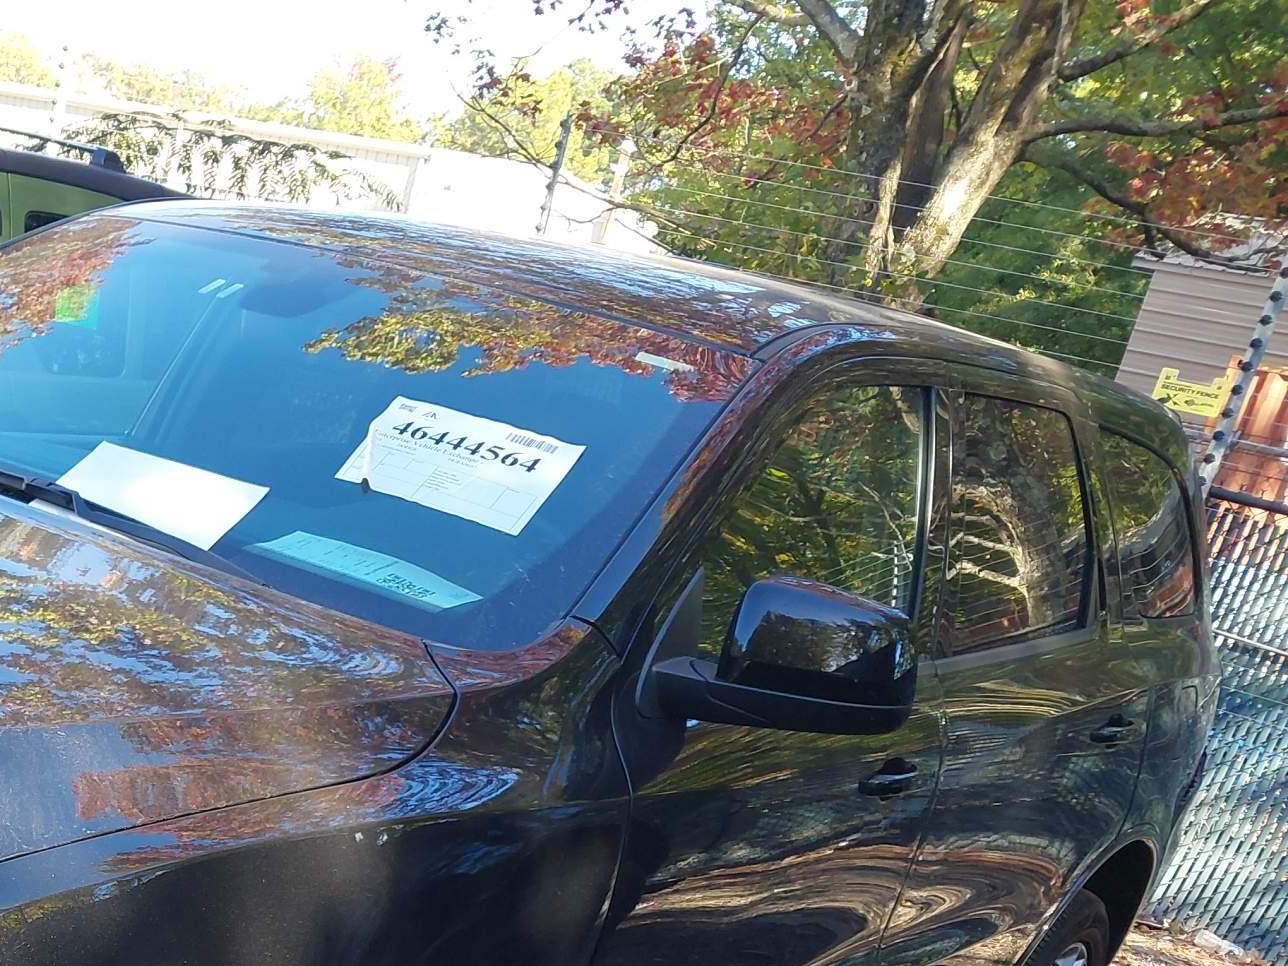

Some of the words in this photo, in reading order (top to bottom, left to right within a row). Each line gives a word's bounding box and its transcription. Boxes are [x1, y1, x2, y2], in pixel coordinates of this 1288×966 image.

[1161, 384, 1195, 395] SECURITY
[1197, 391, 1219, 399] FENCE
[392, 421, 542, 472] 46444564
[414, 441, 442, 454] Vehicle
[442, 449, 479, 464] Exchange
